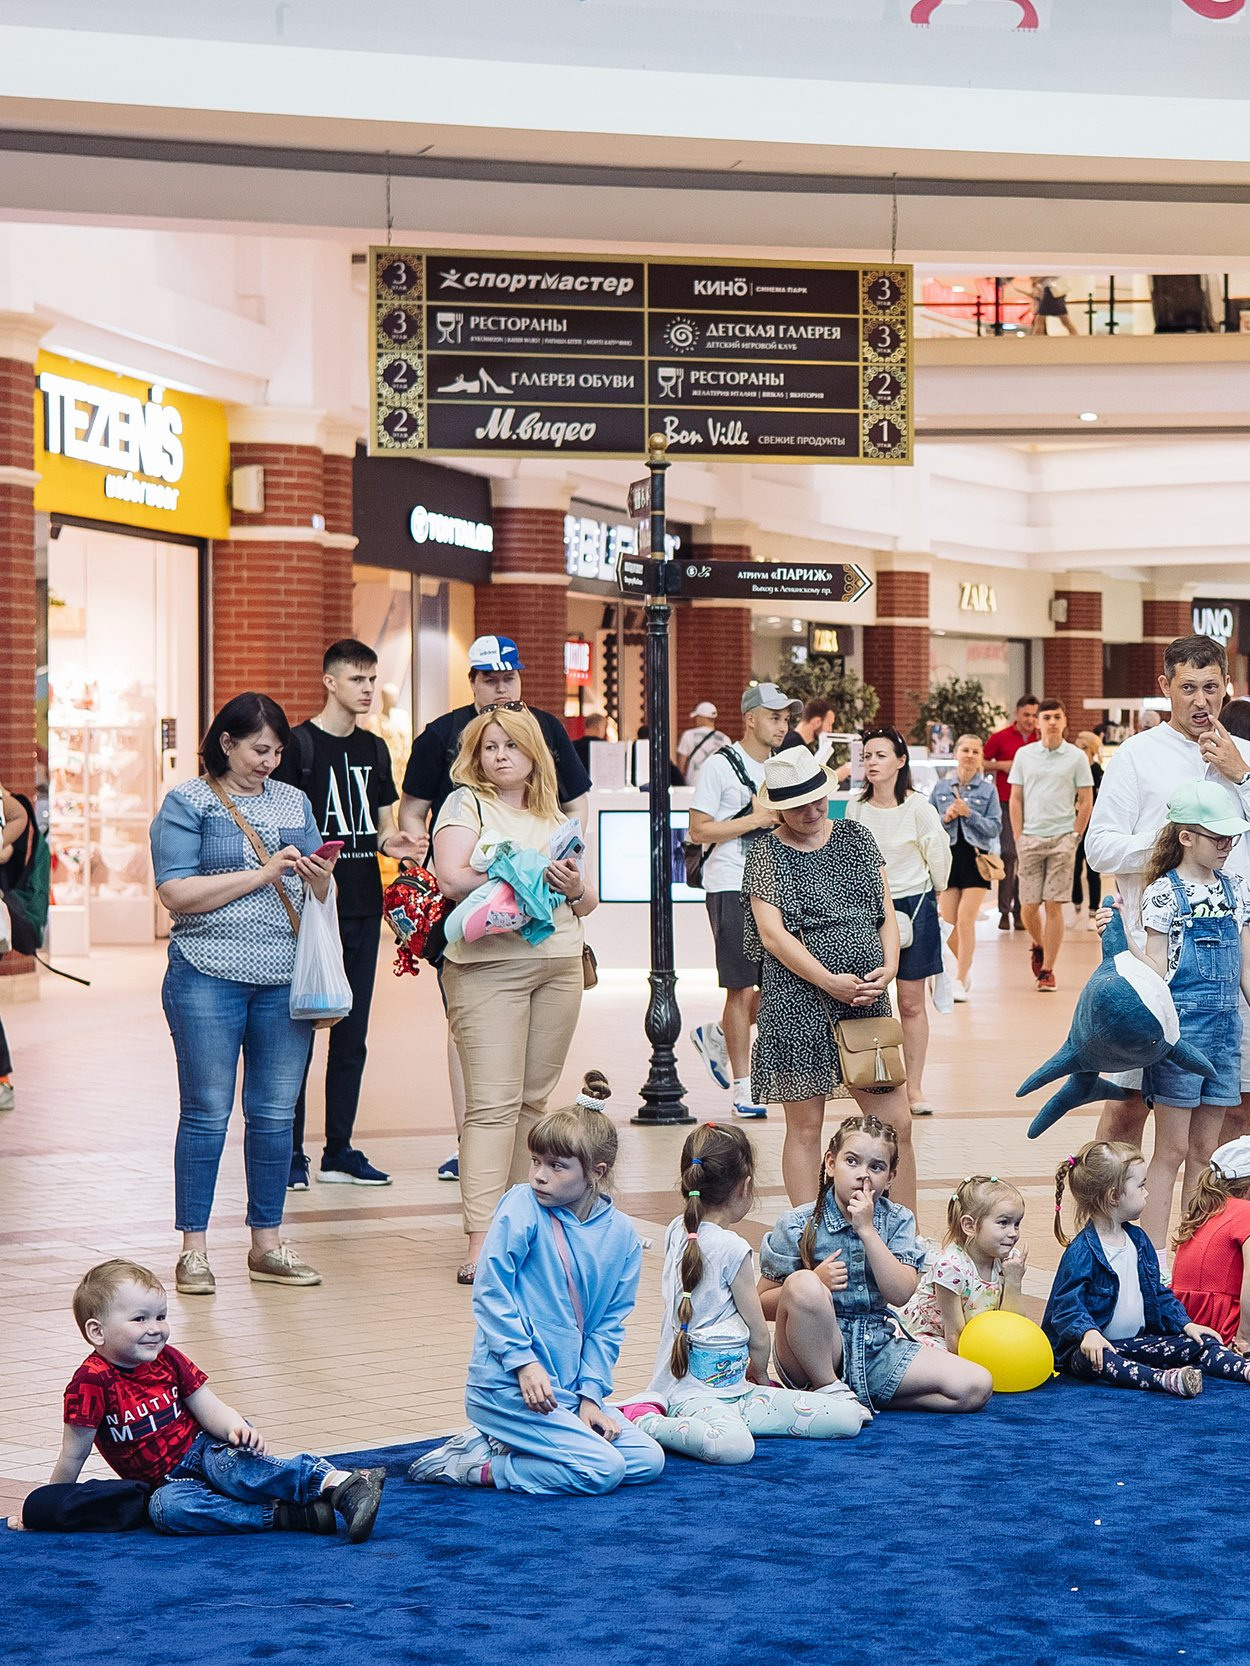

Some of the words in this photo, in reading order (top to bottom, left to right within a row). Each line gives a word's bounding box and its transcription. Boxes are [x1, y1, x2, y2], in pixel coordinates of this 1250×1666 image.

[392, 261, 407, 285] 3
[877, 278, 891, 301] 3
[392, 310, 407, 334] 3
[469, 316, 568, 332] РЕСТОРАНЫ
[706, 323, 775, 339] ДЕТСКАЯ
[779, 325, 841, 341] ГАЛЕРЕЯ
[877, 325, 891, 347] 3
[393, 360, 408, 384] 2
[511, 372, 575, 387] ГАЛЕРЕЯ
[579, 373, 635, 389] ОБУВИ
[690, 371, 785, 386] РЕСТОРАНЫ
[877, 373, 891, 395] 2
[393, 408, 408, 432] 2
[475, 408, 597, 448] М.видео
[878, 420, 889, 442] 1
[663, 416, 704, 447] Bon
[707, 417, 750, 447] Ville
[758, 435, 796, 446] СВЕЖИЕ
[797, 436, 846, 447] ПРОДУКТЫ
[737, 571, 769, 580] АТРИУМ
[770, 568, 833, 582] «ПАРИЖ»
[752, 584, 774, 595] Выход
[779, 585, 821, 596] Ленинскому
[821, 588, 833, 596] пр.
[960, 582, 998, 613] ZARA
